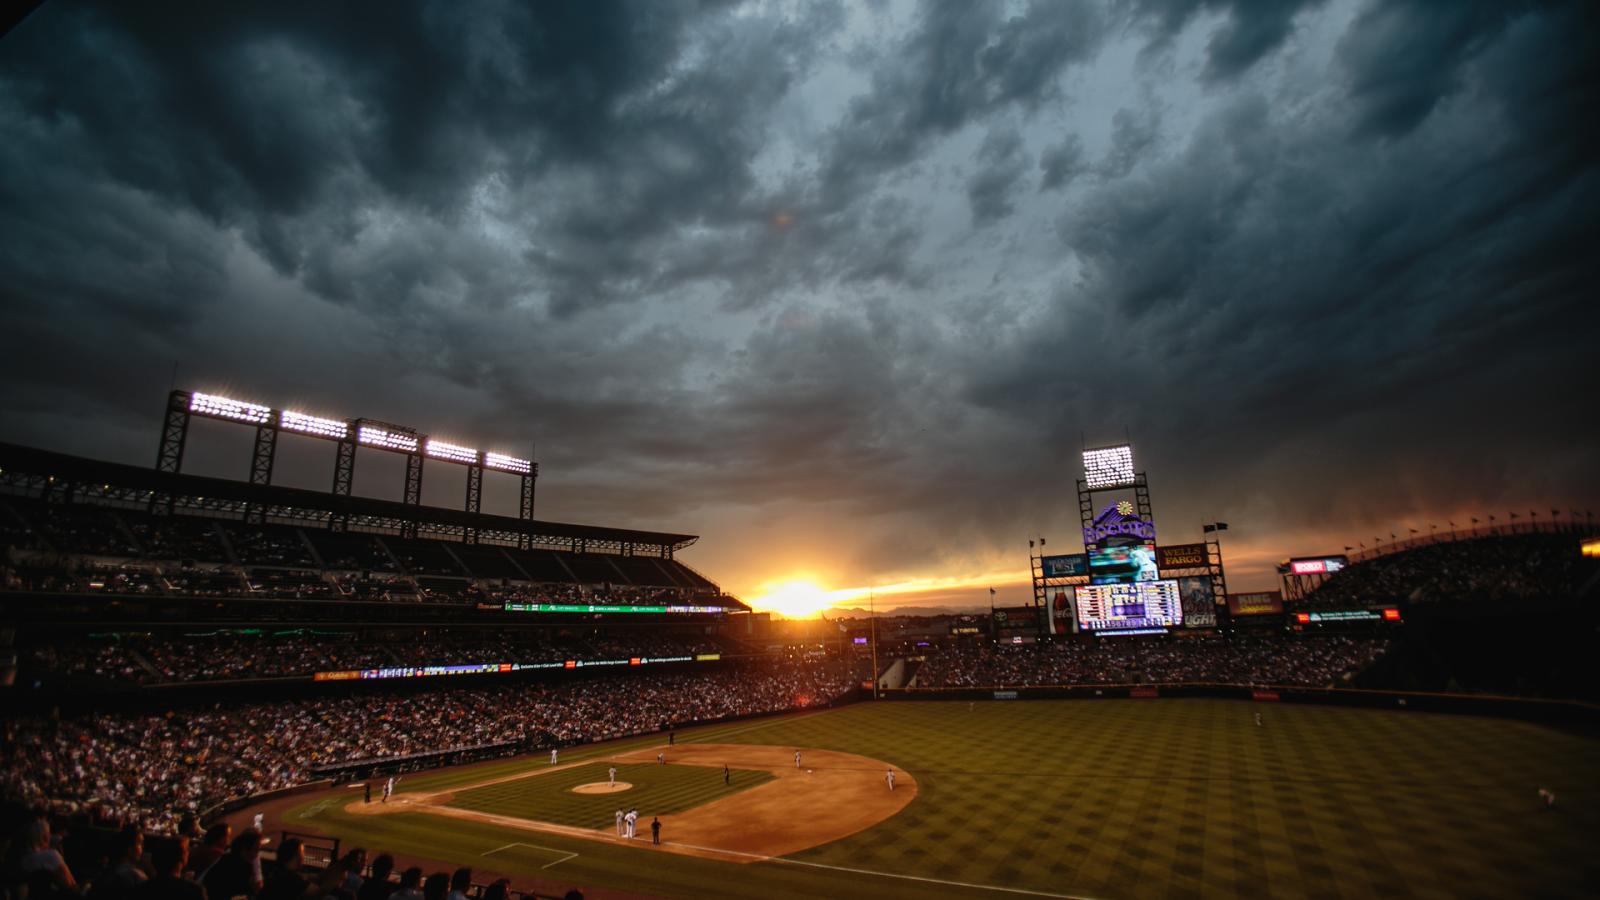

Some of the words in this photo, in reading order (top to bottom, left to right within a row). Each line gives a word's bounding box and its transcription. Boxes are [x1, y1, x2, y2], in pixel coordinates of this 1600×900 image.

[1164, 549, 1201, 559] WELLS
[1166, 556, 1202, 565] FARGO
[1184, 613, 1217, 626] LIGHT
